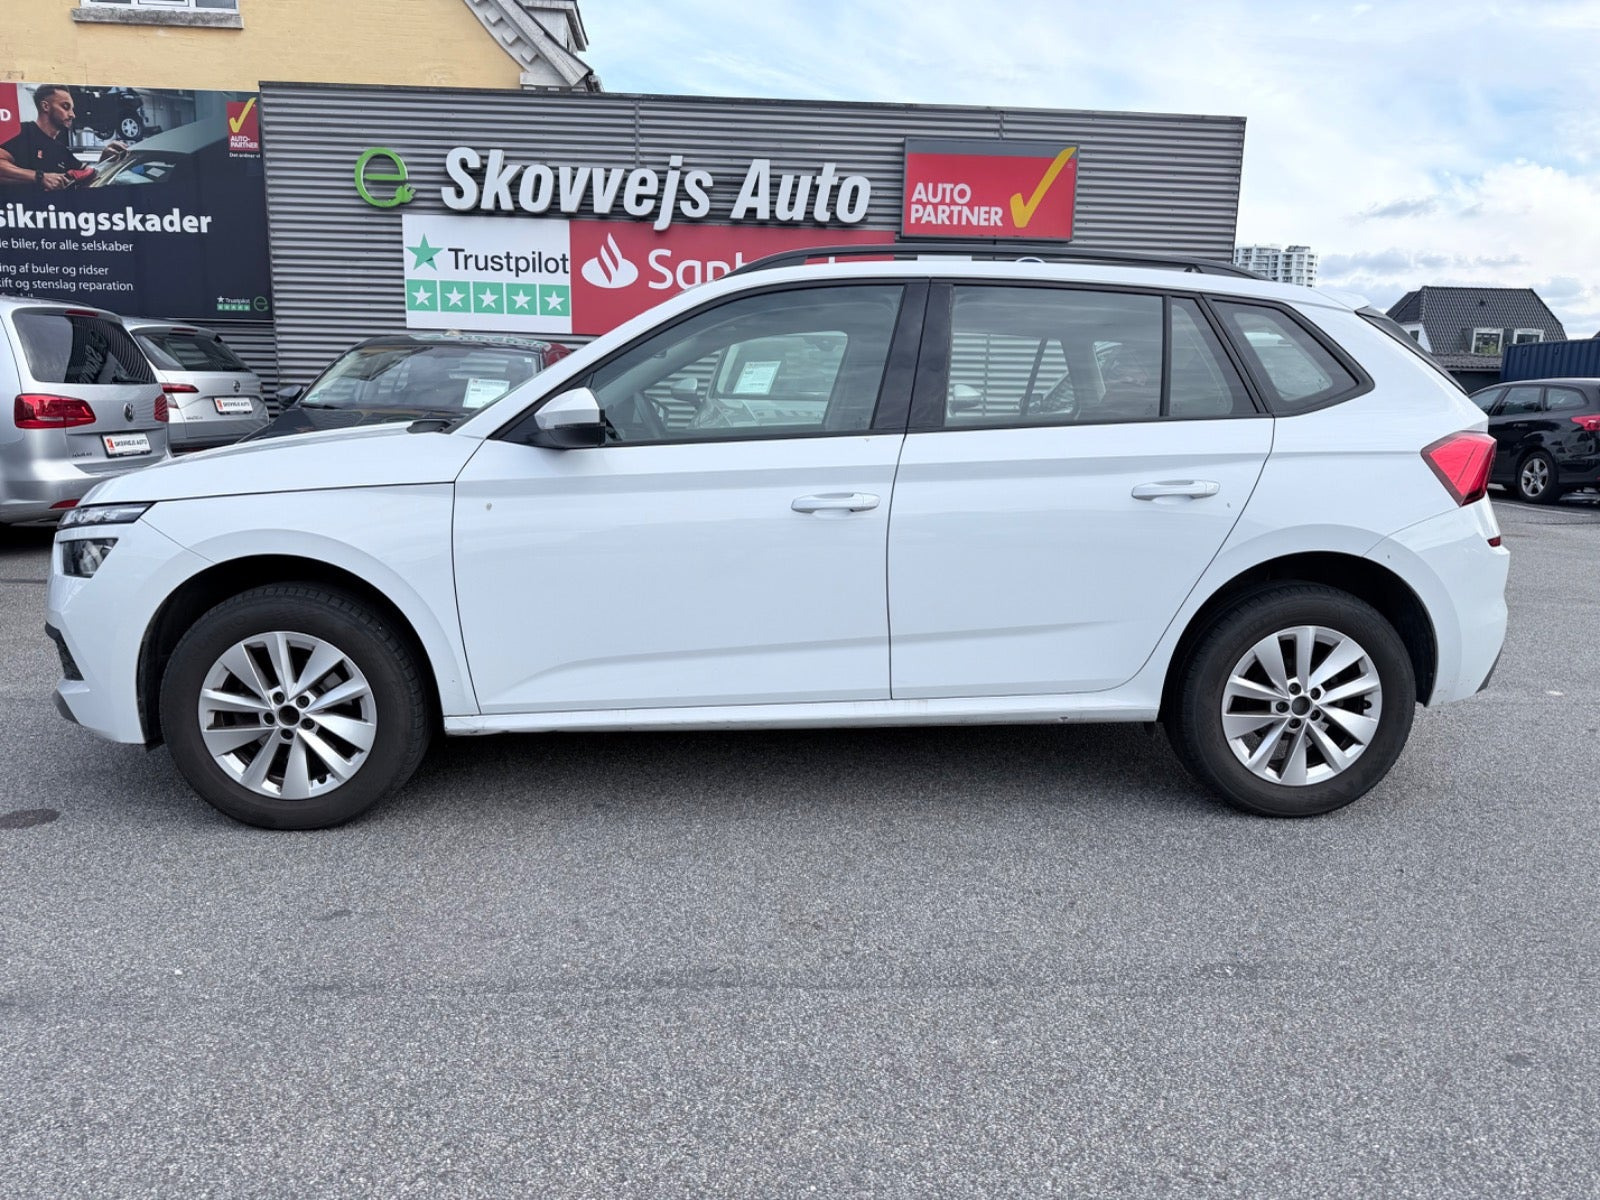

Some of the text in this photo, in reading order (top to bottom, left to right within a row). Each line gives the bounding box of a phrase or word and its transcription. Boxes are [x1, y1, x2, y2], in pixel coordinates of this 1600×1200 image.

[440, 146, 872, 231] Skovvejs Auto
[911, 182, 971, 204] AUTO
[910, 204, 1003, 226] PARTNER
[11, 237, 39, 251] biler,
[41, 238, 57, 250] for
[59, 239, 79, 250] alle
[81, 239, 134, 252] selskaber
[19, 262, 30, 273] af
[32, 263, 60, 274] buler
[62, 267, 76, 277] og
[79, 264, 109, 275] ridser
[448, 247, 570, 277] Trustpilot
[15, 280, 30, 291] og
[32, 279, 76, 292] stenslag
[78, 280, 134, 292] reparation
